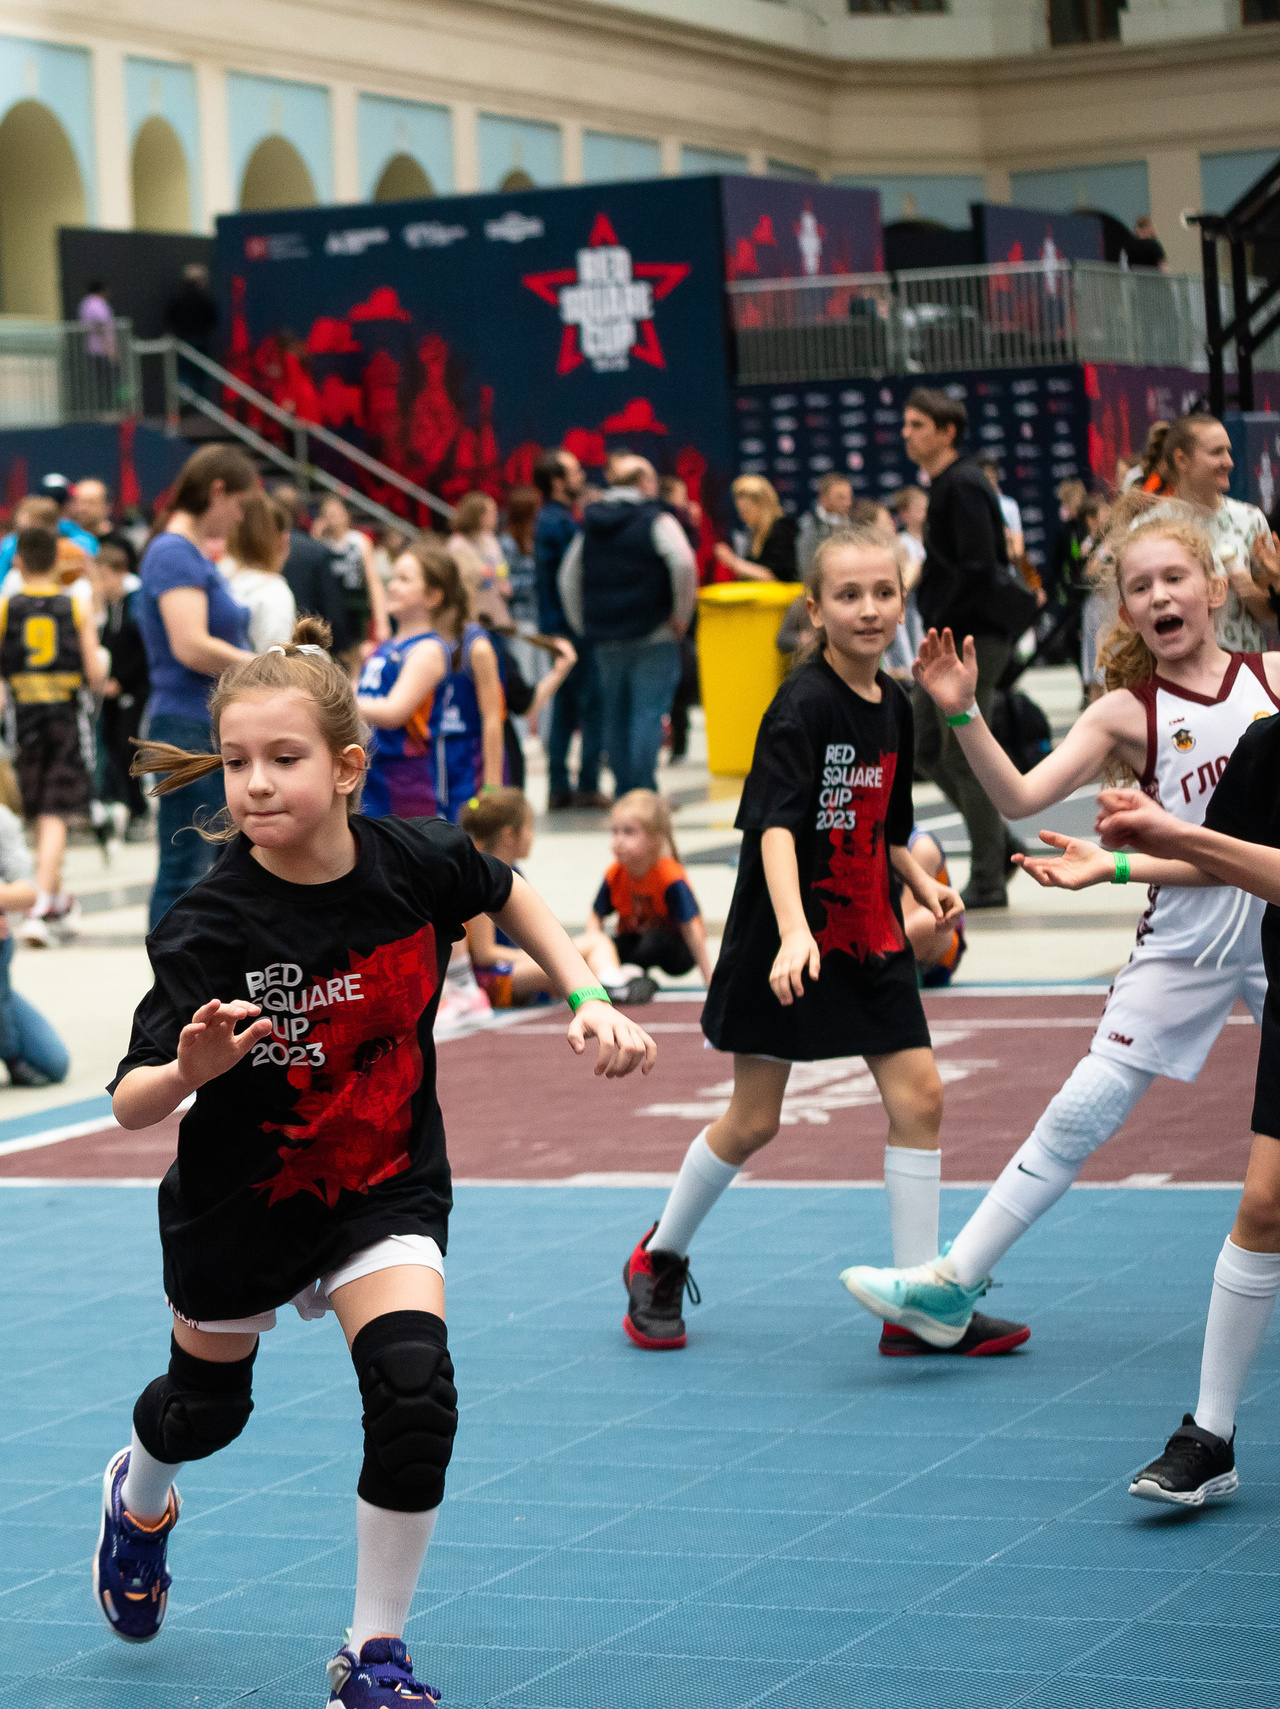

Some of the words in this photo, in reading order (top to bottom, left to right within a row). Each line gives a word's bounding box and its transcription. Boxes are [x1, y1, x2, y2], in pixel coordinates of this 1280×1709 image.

[23, 613, 59, 668] 9
[825, 743, 855, 765] RED
[821, 766, 883, 788] SQUARE
[819, 788, 852, 808] CUP
[816, 810, 856, 830] 2023
[245, 963, 303, 998] RED
[258, 1014, 310, 1042] UP
[250, 1042, 326, 1067] 2023
